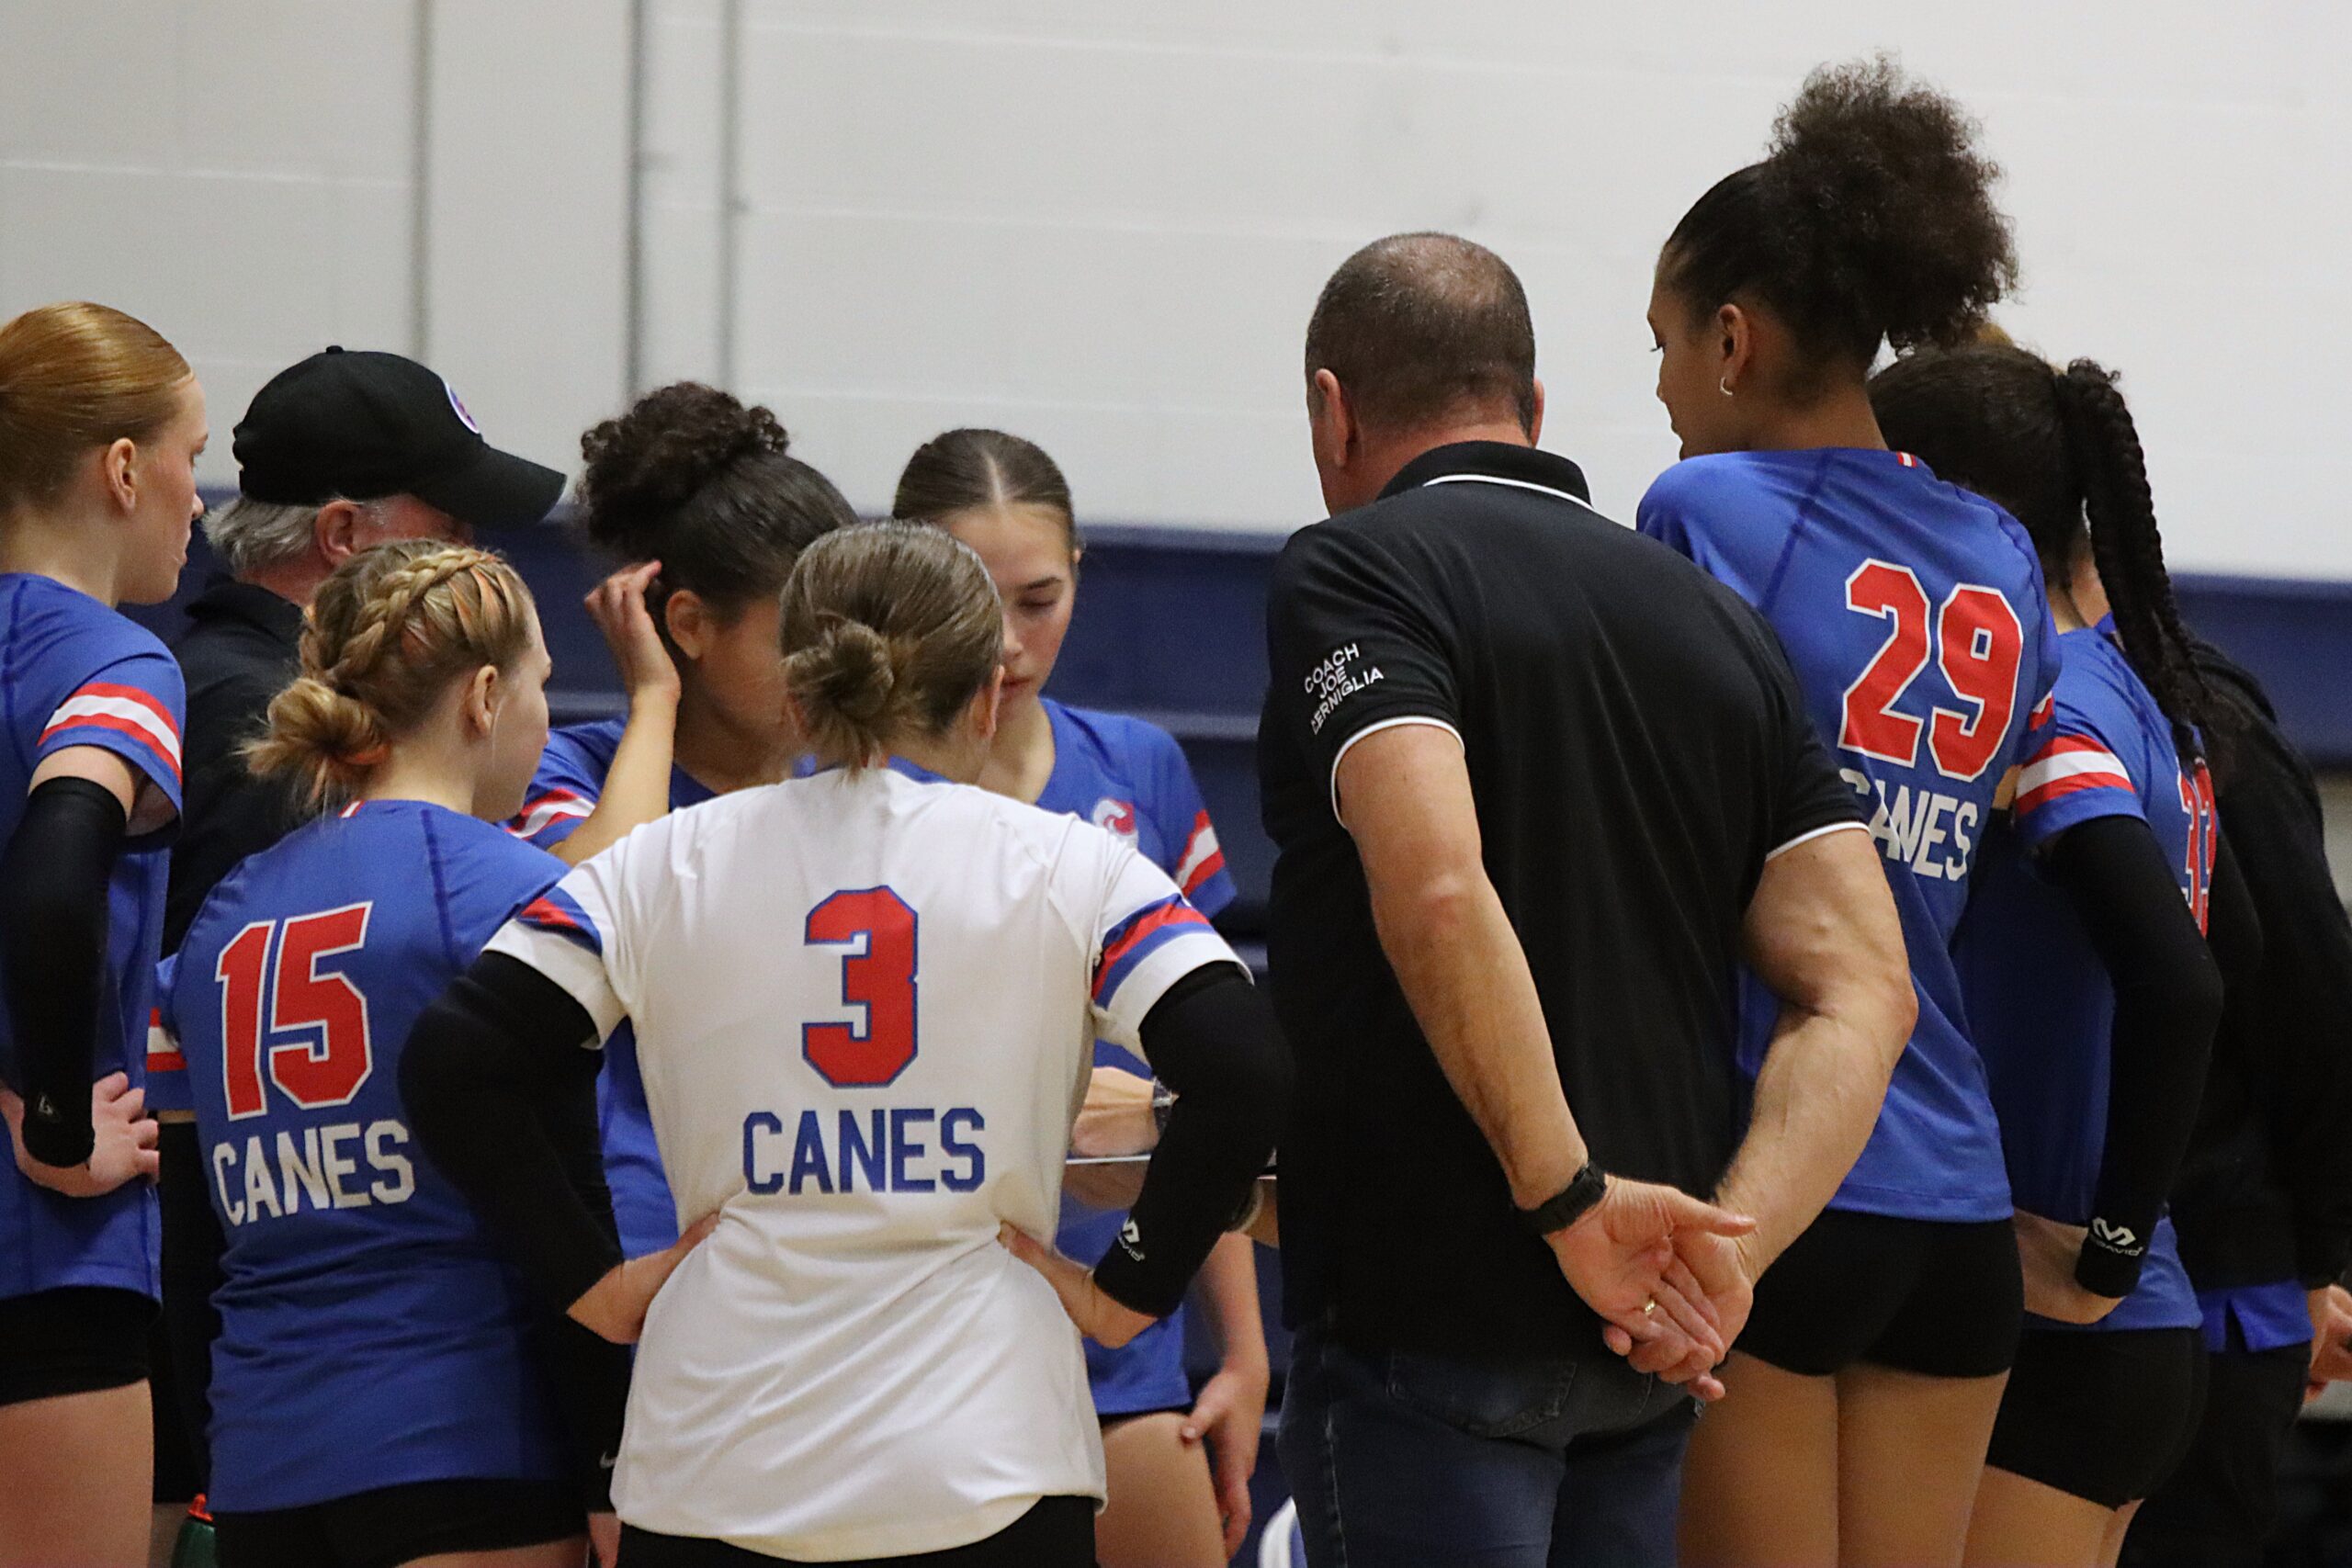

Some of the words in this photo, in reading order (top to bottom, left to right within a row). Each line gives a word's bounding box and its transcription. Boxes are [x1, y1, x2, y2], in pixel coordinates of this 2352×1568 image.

[1305, 643, 1360, 694] COACH
[1311, 667, 1384, 735] CERNIGLIA
[1320, 666, 1347, 699] JOE
[1838, 558, 2023, 783] 29
[215, 901, 373, 1122] 15
[802, 885, 918, 1089] 3
[213, 1119, 415, 1226] CANES
[743, 1107, 984, 1195] CANES
